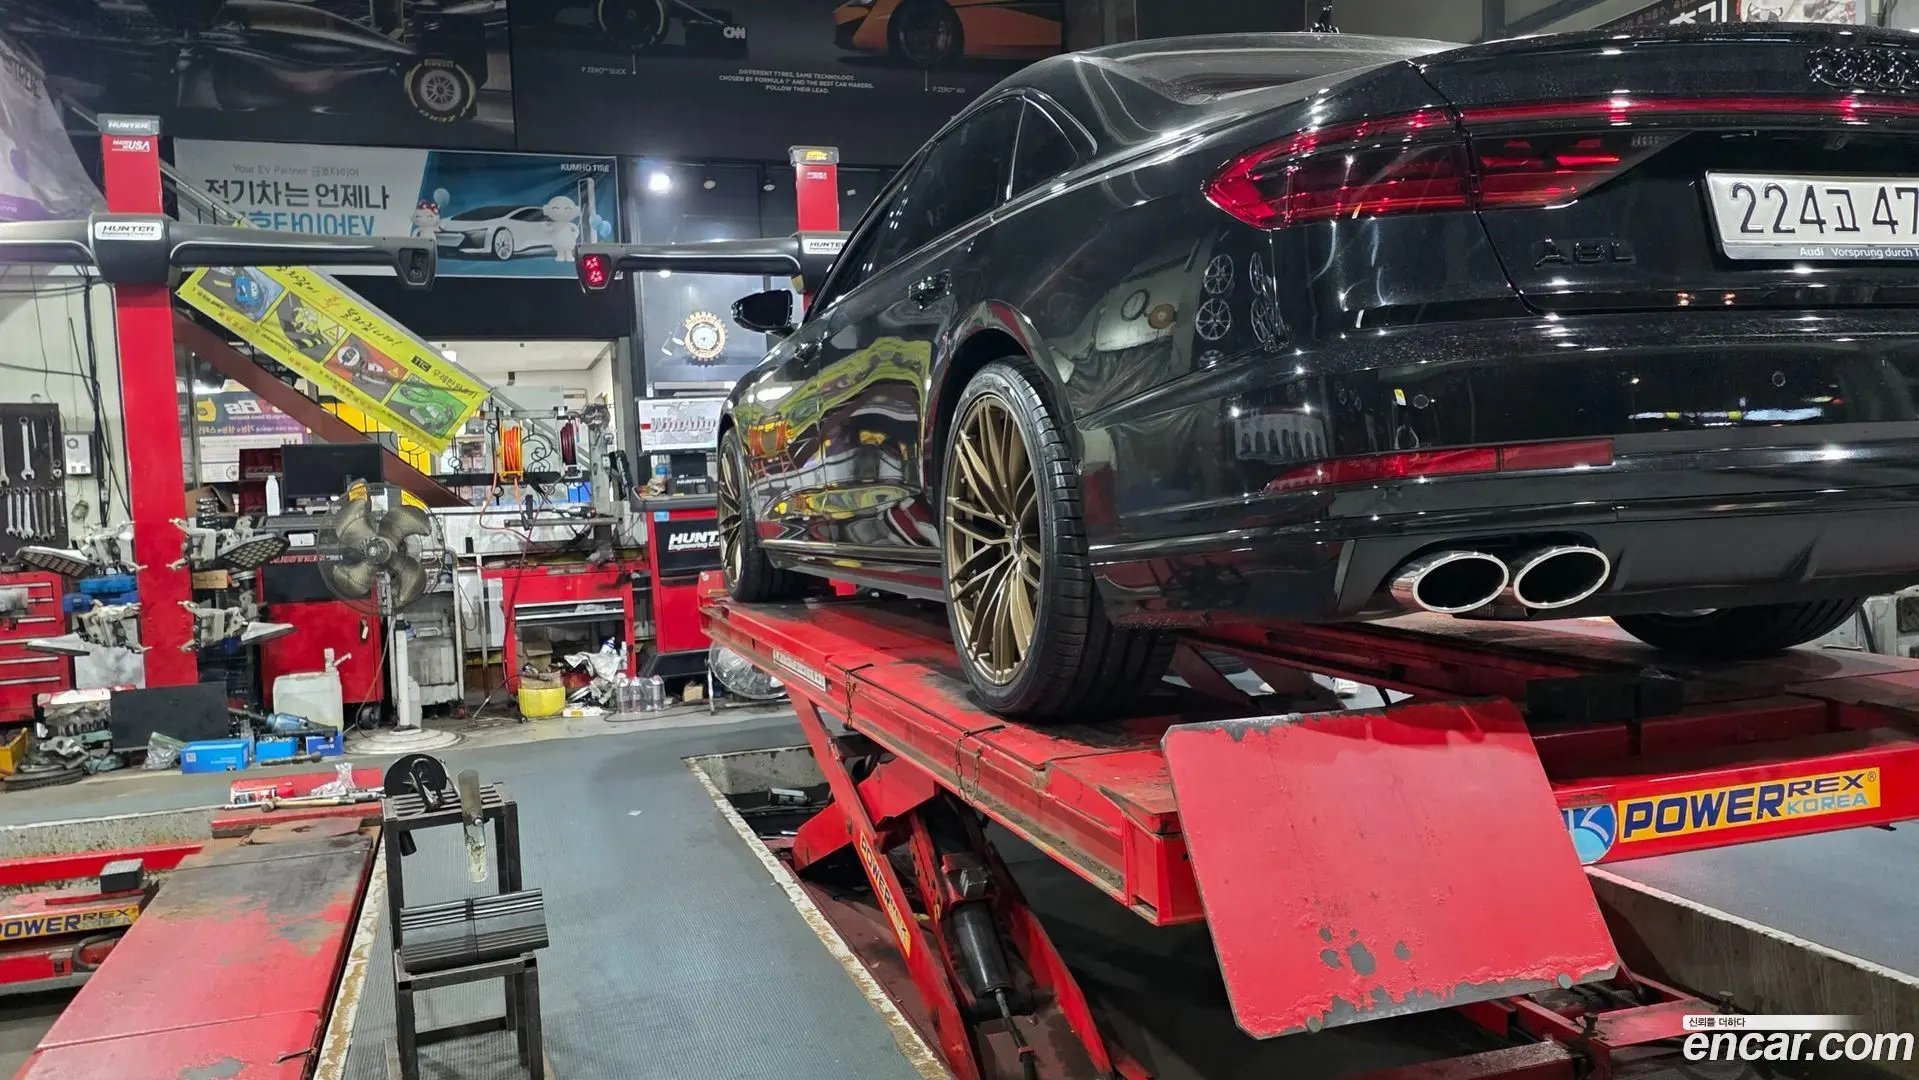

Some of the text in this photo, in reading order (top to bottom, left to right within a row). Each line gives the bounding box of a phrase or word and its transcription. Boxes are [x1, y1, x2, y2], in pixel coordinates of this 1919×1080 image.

[723, 26, 746, 39] CNN
[738, 68, 772, 77] DIFFERENT
[108, 121, 148, 129] HUNTER
[128, 140, 150, 151] USA
[233, 164, 360, 177] Your EV Partner 금호타이어
[561, 163, 609, 173] KUMHO TIRE
[204, 179, 390, 210] 전기차는 언제나
[1731, 181, 1860, 234] 224고
[102, 225, 155, 233] HUNTER
[243, 210, 375, 236] 호타이어EV
[1800, 247, 1824, 256] Audi
[1831, 247, 1884, 259] Vorsprung
[1885, 248, 1912, 258] durch
[670, 530, 719, 545] HUNT
[1786, 791, 1869, 816] KOREA
[1624, 783, 1785, 838] POWER
[82, 908, 130, 921] REX
